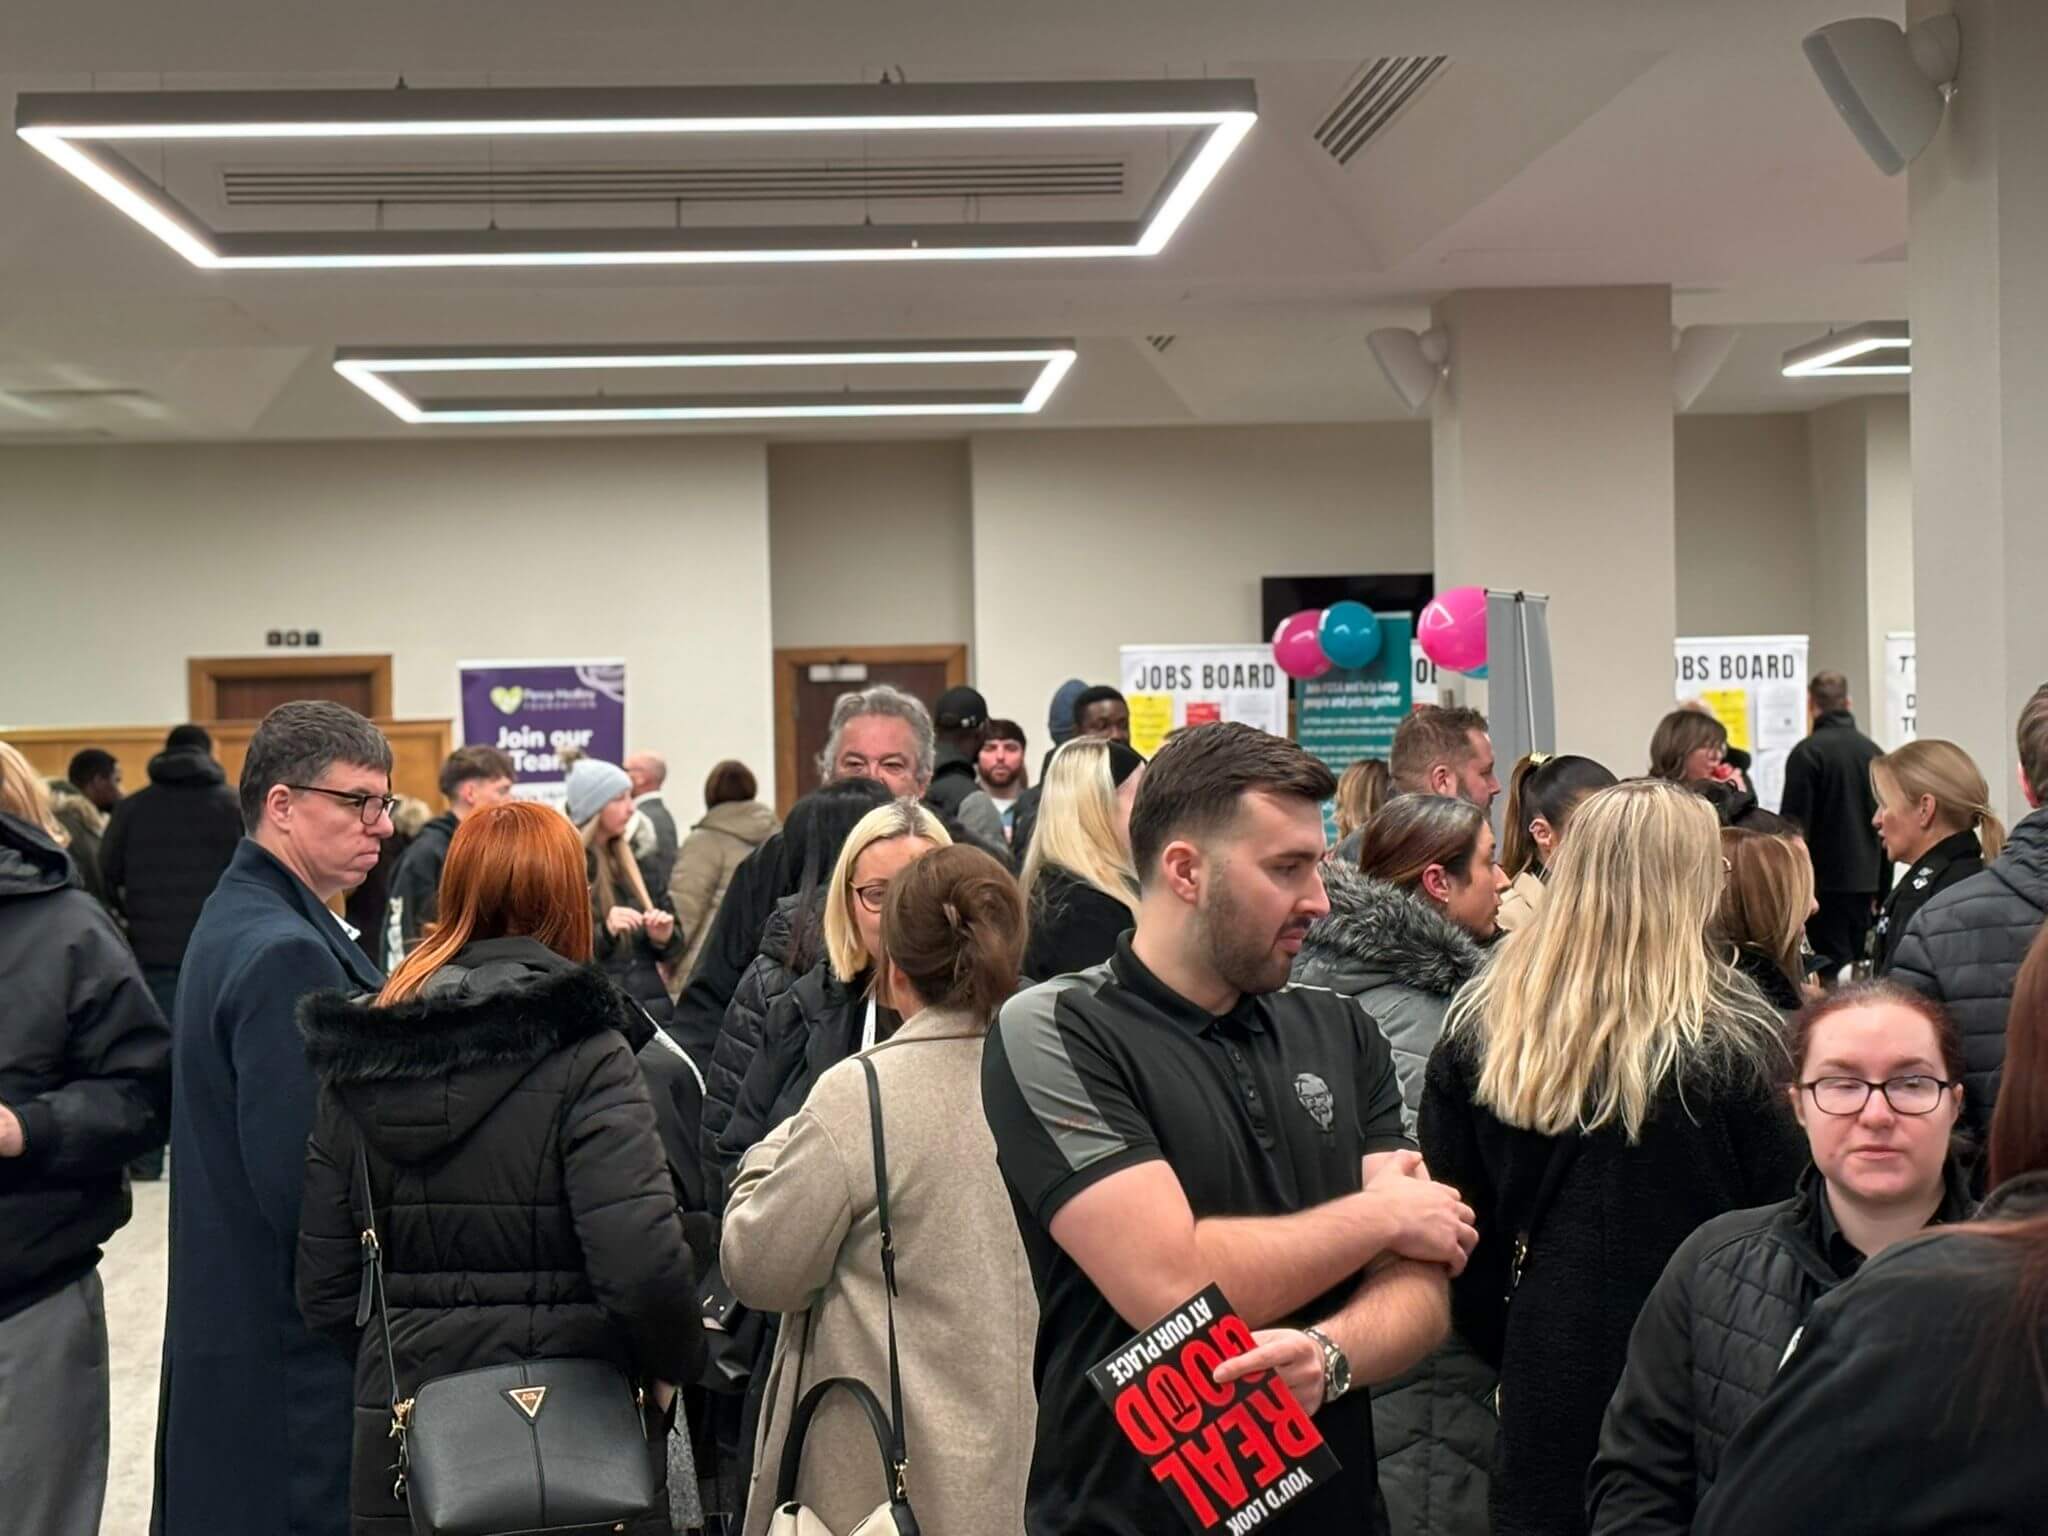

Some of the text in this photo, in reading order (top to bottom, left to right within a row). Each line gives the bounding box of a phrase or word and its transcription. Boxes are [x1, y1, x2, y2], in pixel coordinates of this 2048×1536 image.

[1135, 663, 1276, 691] JOBS BOARD
[1720, 654, 1795, 680] BOARD
[496, 725, 593, 749] Join our
[1106, 1296, 1213, 1386] AT OUR PLACE
[1115, 1314, 1266, 1456] GOOD
[1151, 1376, 1324, 1529] REAL
[1225, 1466, 1313, 1536] YOU'D LOOK
